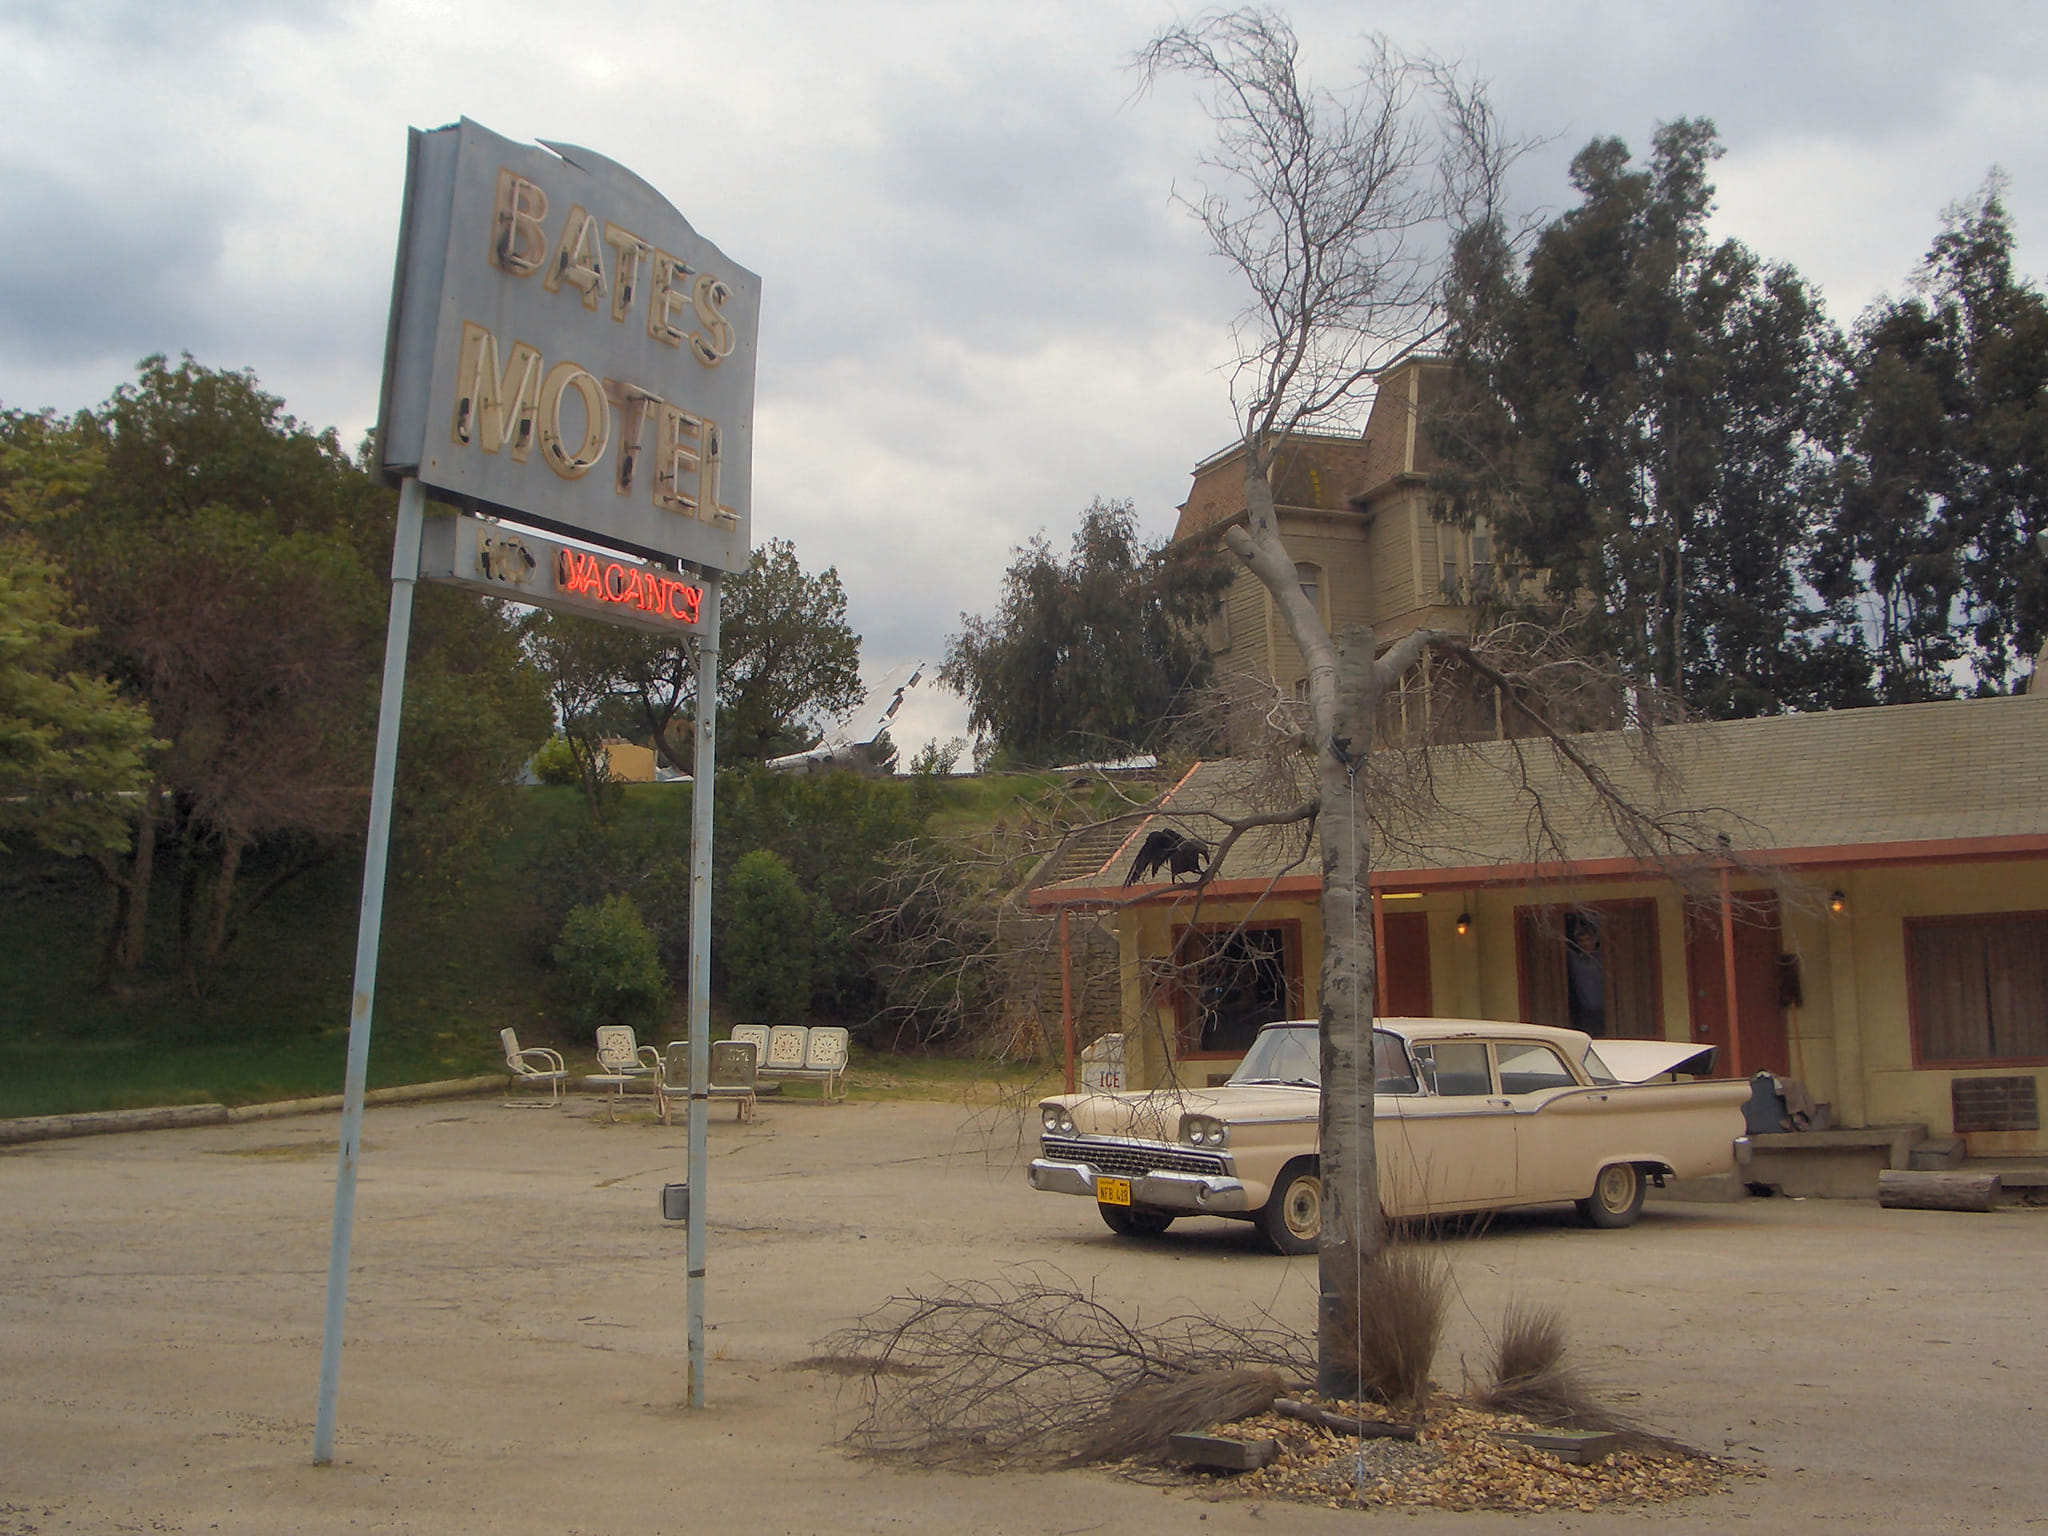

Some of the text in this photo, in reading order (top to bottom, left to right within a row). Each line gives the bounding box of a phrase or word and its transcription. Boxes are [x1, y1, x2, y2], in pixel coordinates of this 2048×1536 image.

[488, 168, 735, 369] BATES
[451, 319, 742, 533] MOTEL
[476, 527, 703, 624] NO VACANCY
[1099, 1070, 1121, 1089] ICE
